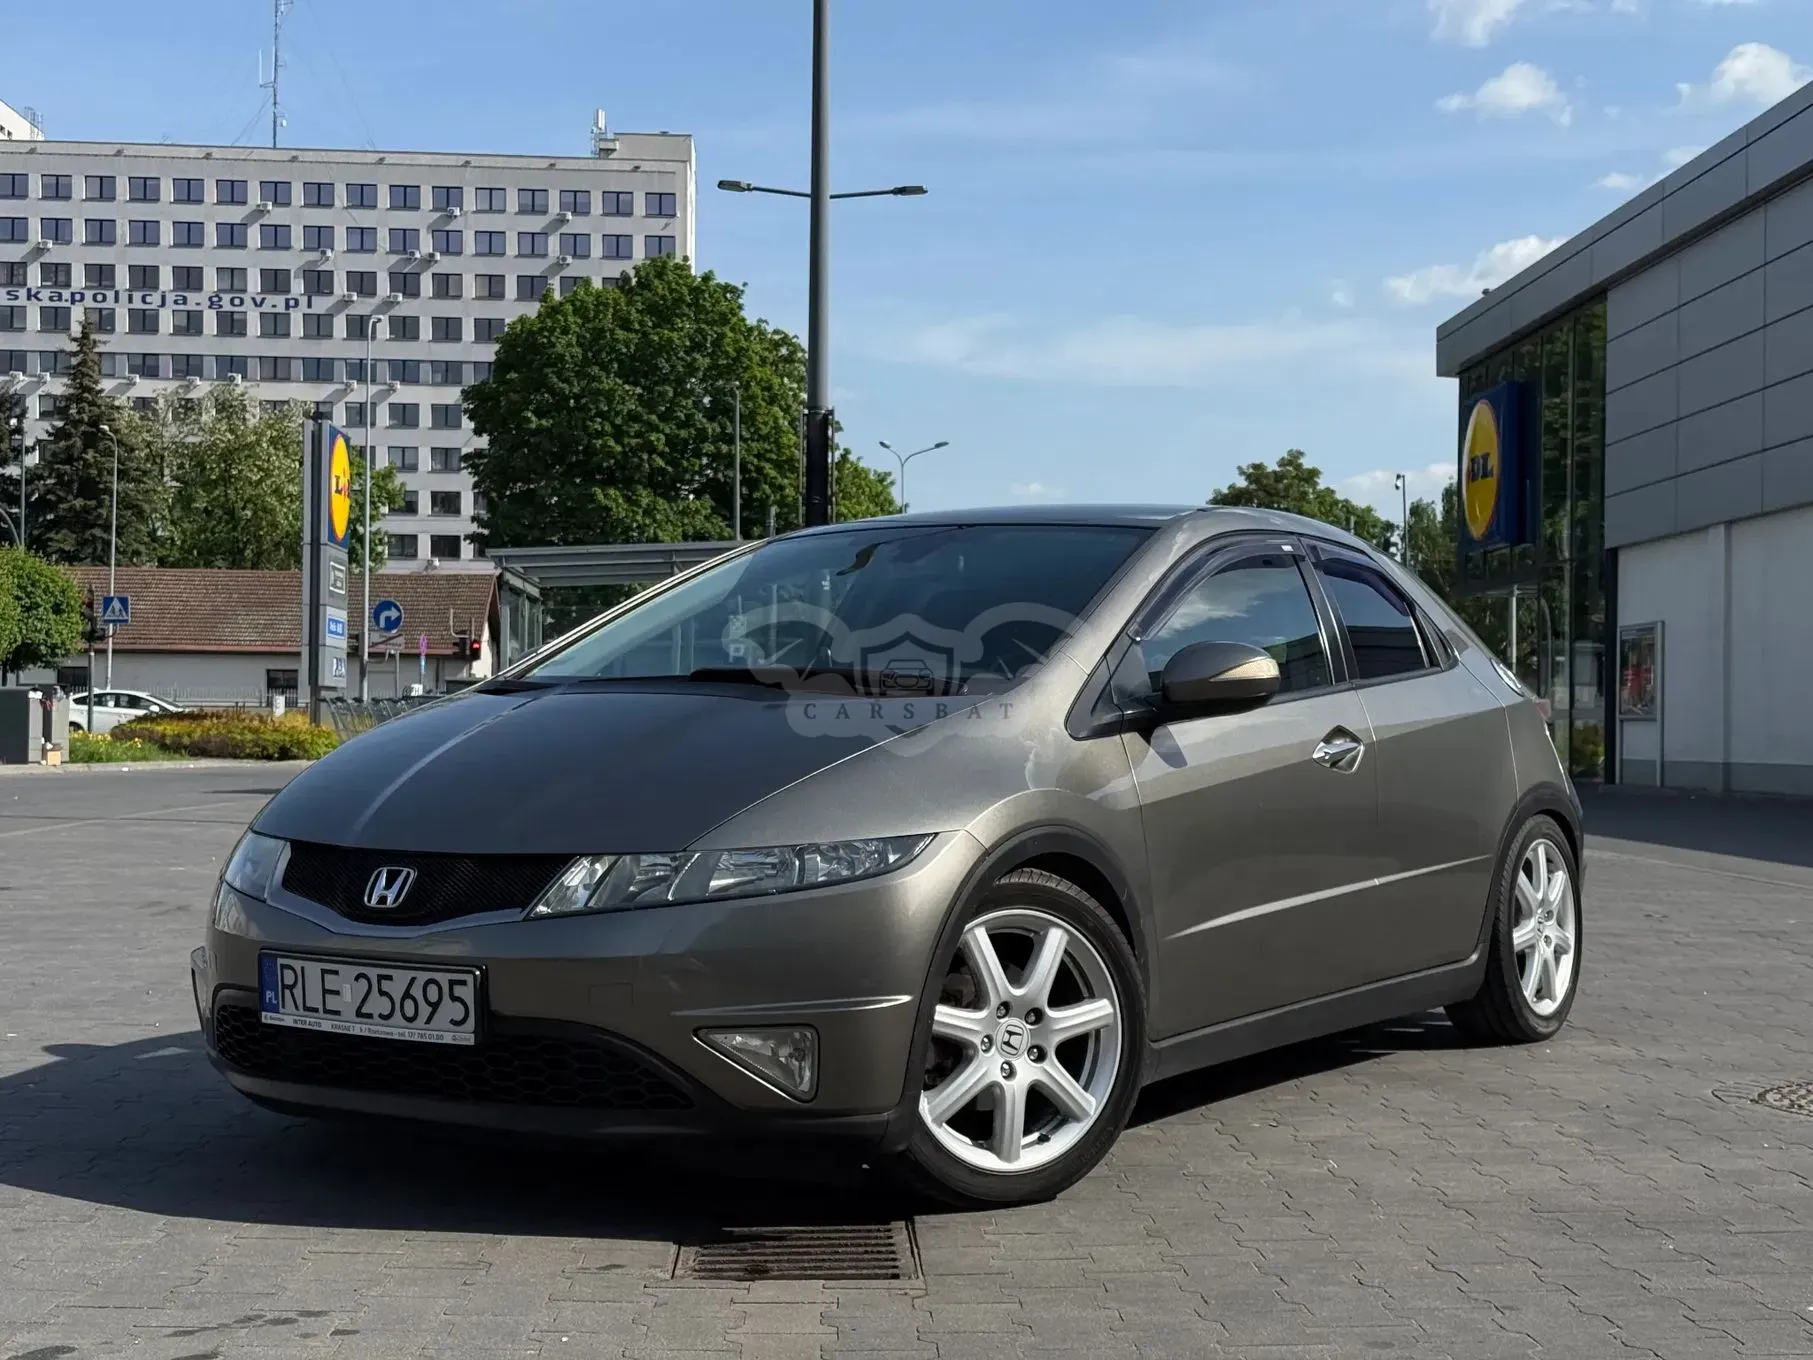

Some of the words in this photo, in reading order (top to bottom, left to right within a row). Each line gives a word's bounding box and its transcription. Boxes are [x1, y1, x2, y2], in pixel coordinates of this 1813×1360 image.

[265, 991, 278, 1004] PL
[279, 963, 342, 1016] RLE
[353, 972, 470, 1027] 25695
